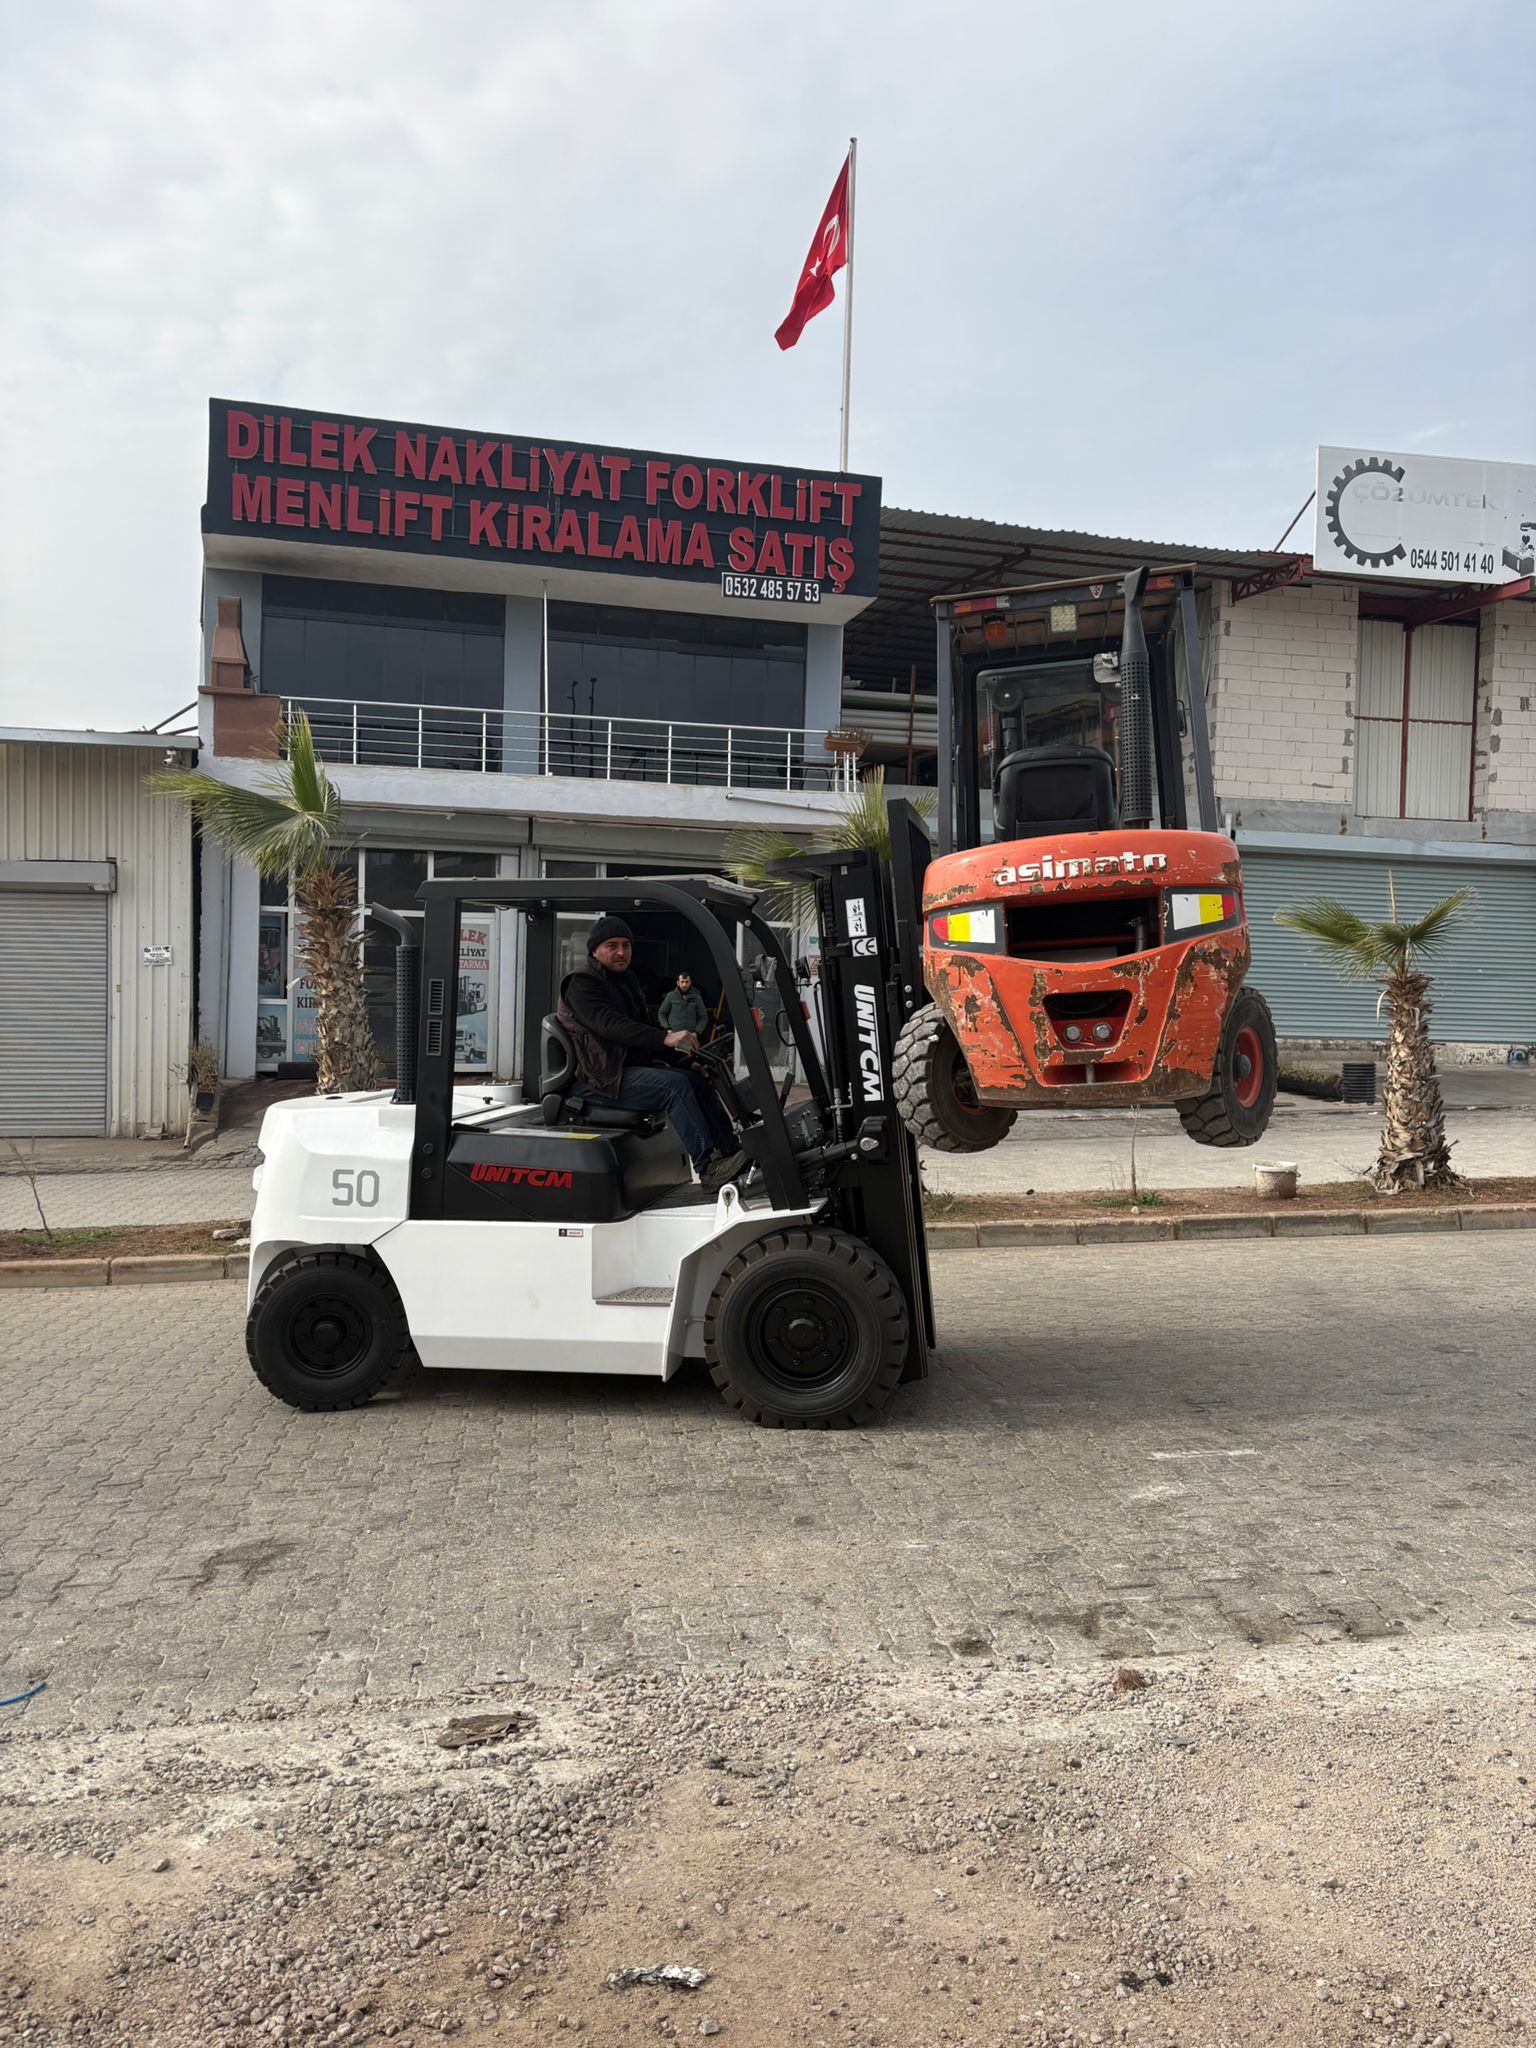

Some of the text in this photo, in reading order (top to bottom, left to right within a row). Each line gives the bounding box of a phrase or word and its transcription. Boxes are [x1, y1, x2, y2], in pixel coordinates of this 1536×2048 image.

[728, 526, 855, 593] SATIŞ
[1410, 548, 1494, 574] 0544 501 41 40
[725, 576, 820, 602] 0532 485 57 53
[993, 851, 1168, 886] asimato
[854, 984, 884, 1102] UNITCM
[332, 1169, 380, 1207] 50
[470, 1162, 574, 1190] UNITCM
